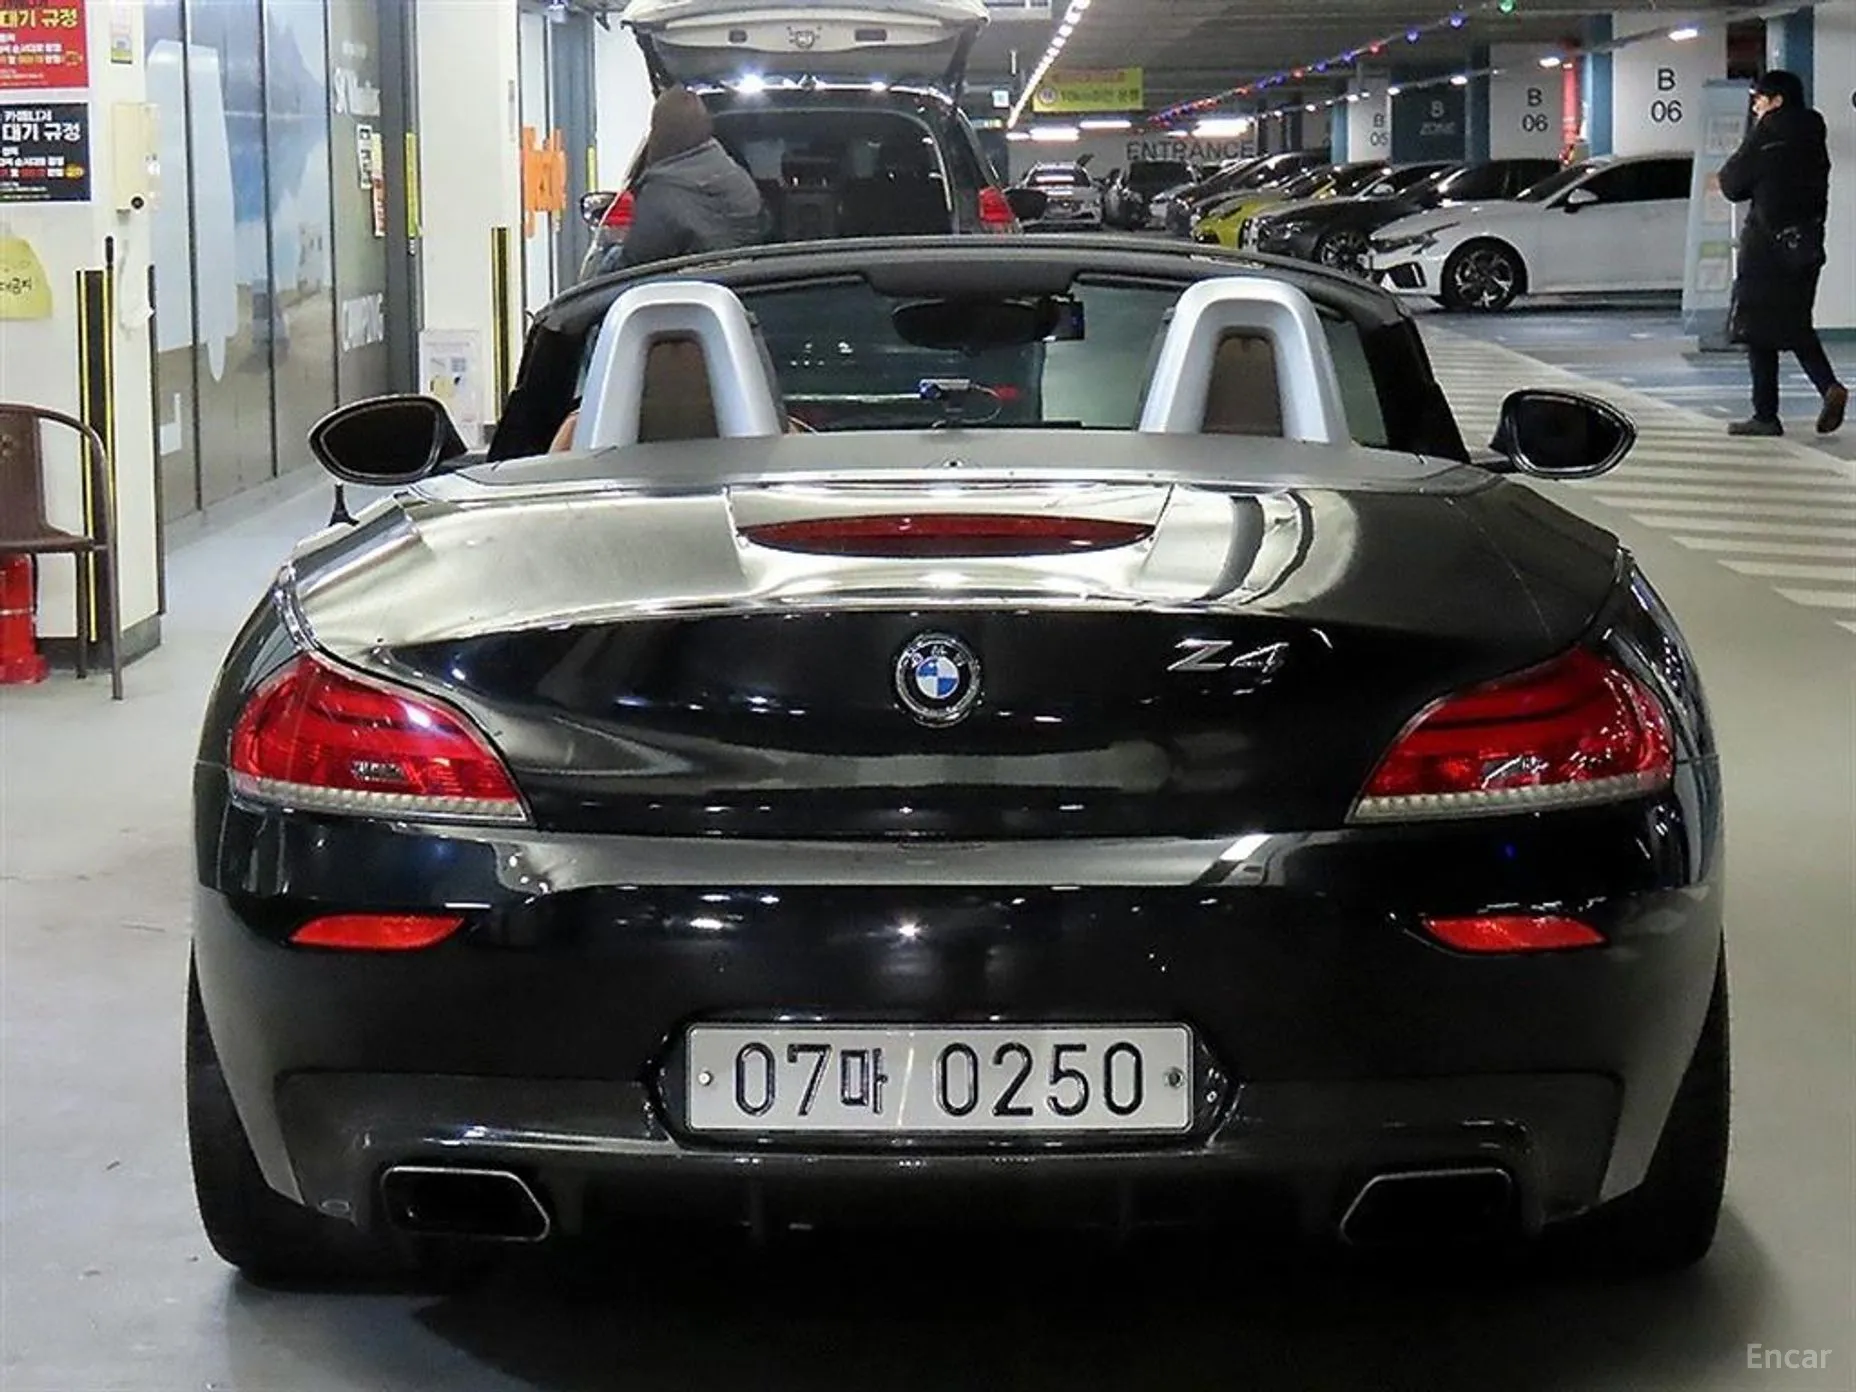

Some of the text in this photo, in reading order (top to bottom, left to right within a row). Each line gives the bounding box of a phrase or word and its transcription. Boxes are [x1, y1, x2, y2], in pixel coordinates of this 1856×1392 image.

[41, 8, 78, 29] 규정
[1657, 68, 1676, 92] B
[1527, 88, 1543, 107] B
[1374, 113, 1385, 128] B
[1651, 99, 1683, 123] 06
[2, 122, 81, 142] 대기 규정
[1522, 114, 1548, 133] 06
[1126, 141, 1257, 161] ENTRANCE
[1167, 638, 1290, 674] Z4
[734, 1041, 1144, 1118] 07마 0250
